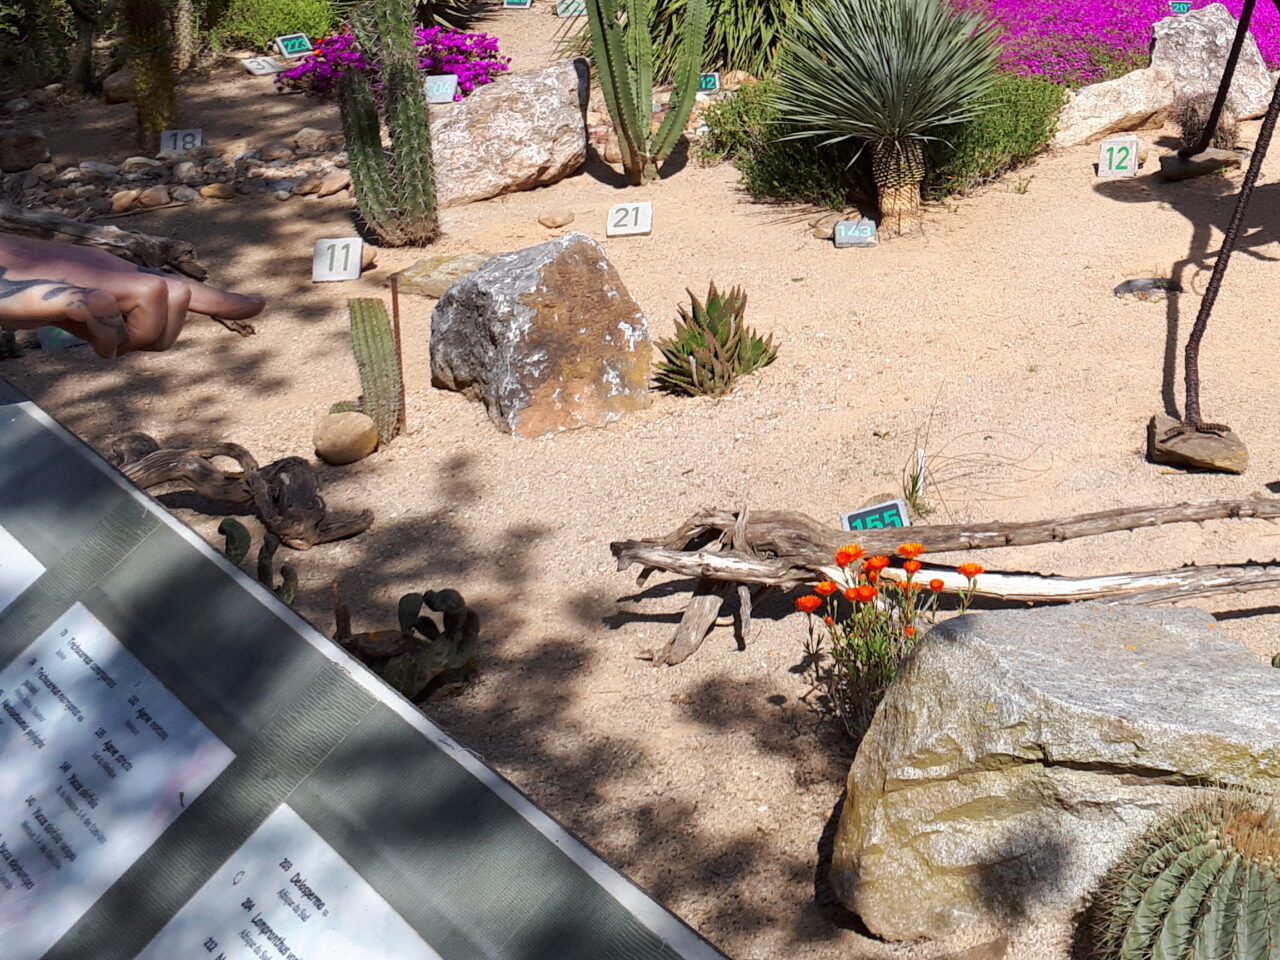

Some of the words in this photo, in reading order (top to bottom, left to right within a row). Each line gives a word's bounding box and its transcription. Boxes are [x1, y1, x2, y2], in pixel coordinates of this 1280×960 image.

[283, 38, 309, 53] 223
[170, 132, 196, 151] 18
[1106, 146, 1130, 170] 12
[612, 206, 640, 228] 21
[838, 225, 872, 237] 143
[327, 243, 351, 272] 11
[851, 509, 902, 531] 155
[290, 872, 326, 910] Delosperma
[251, 912, 291, 956] Lampranthus
